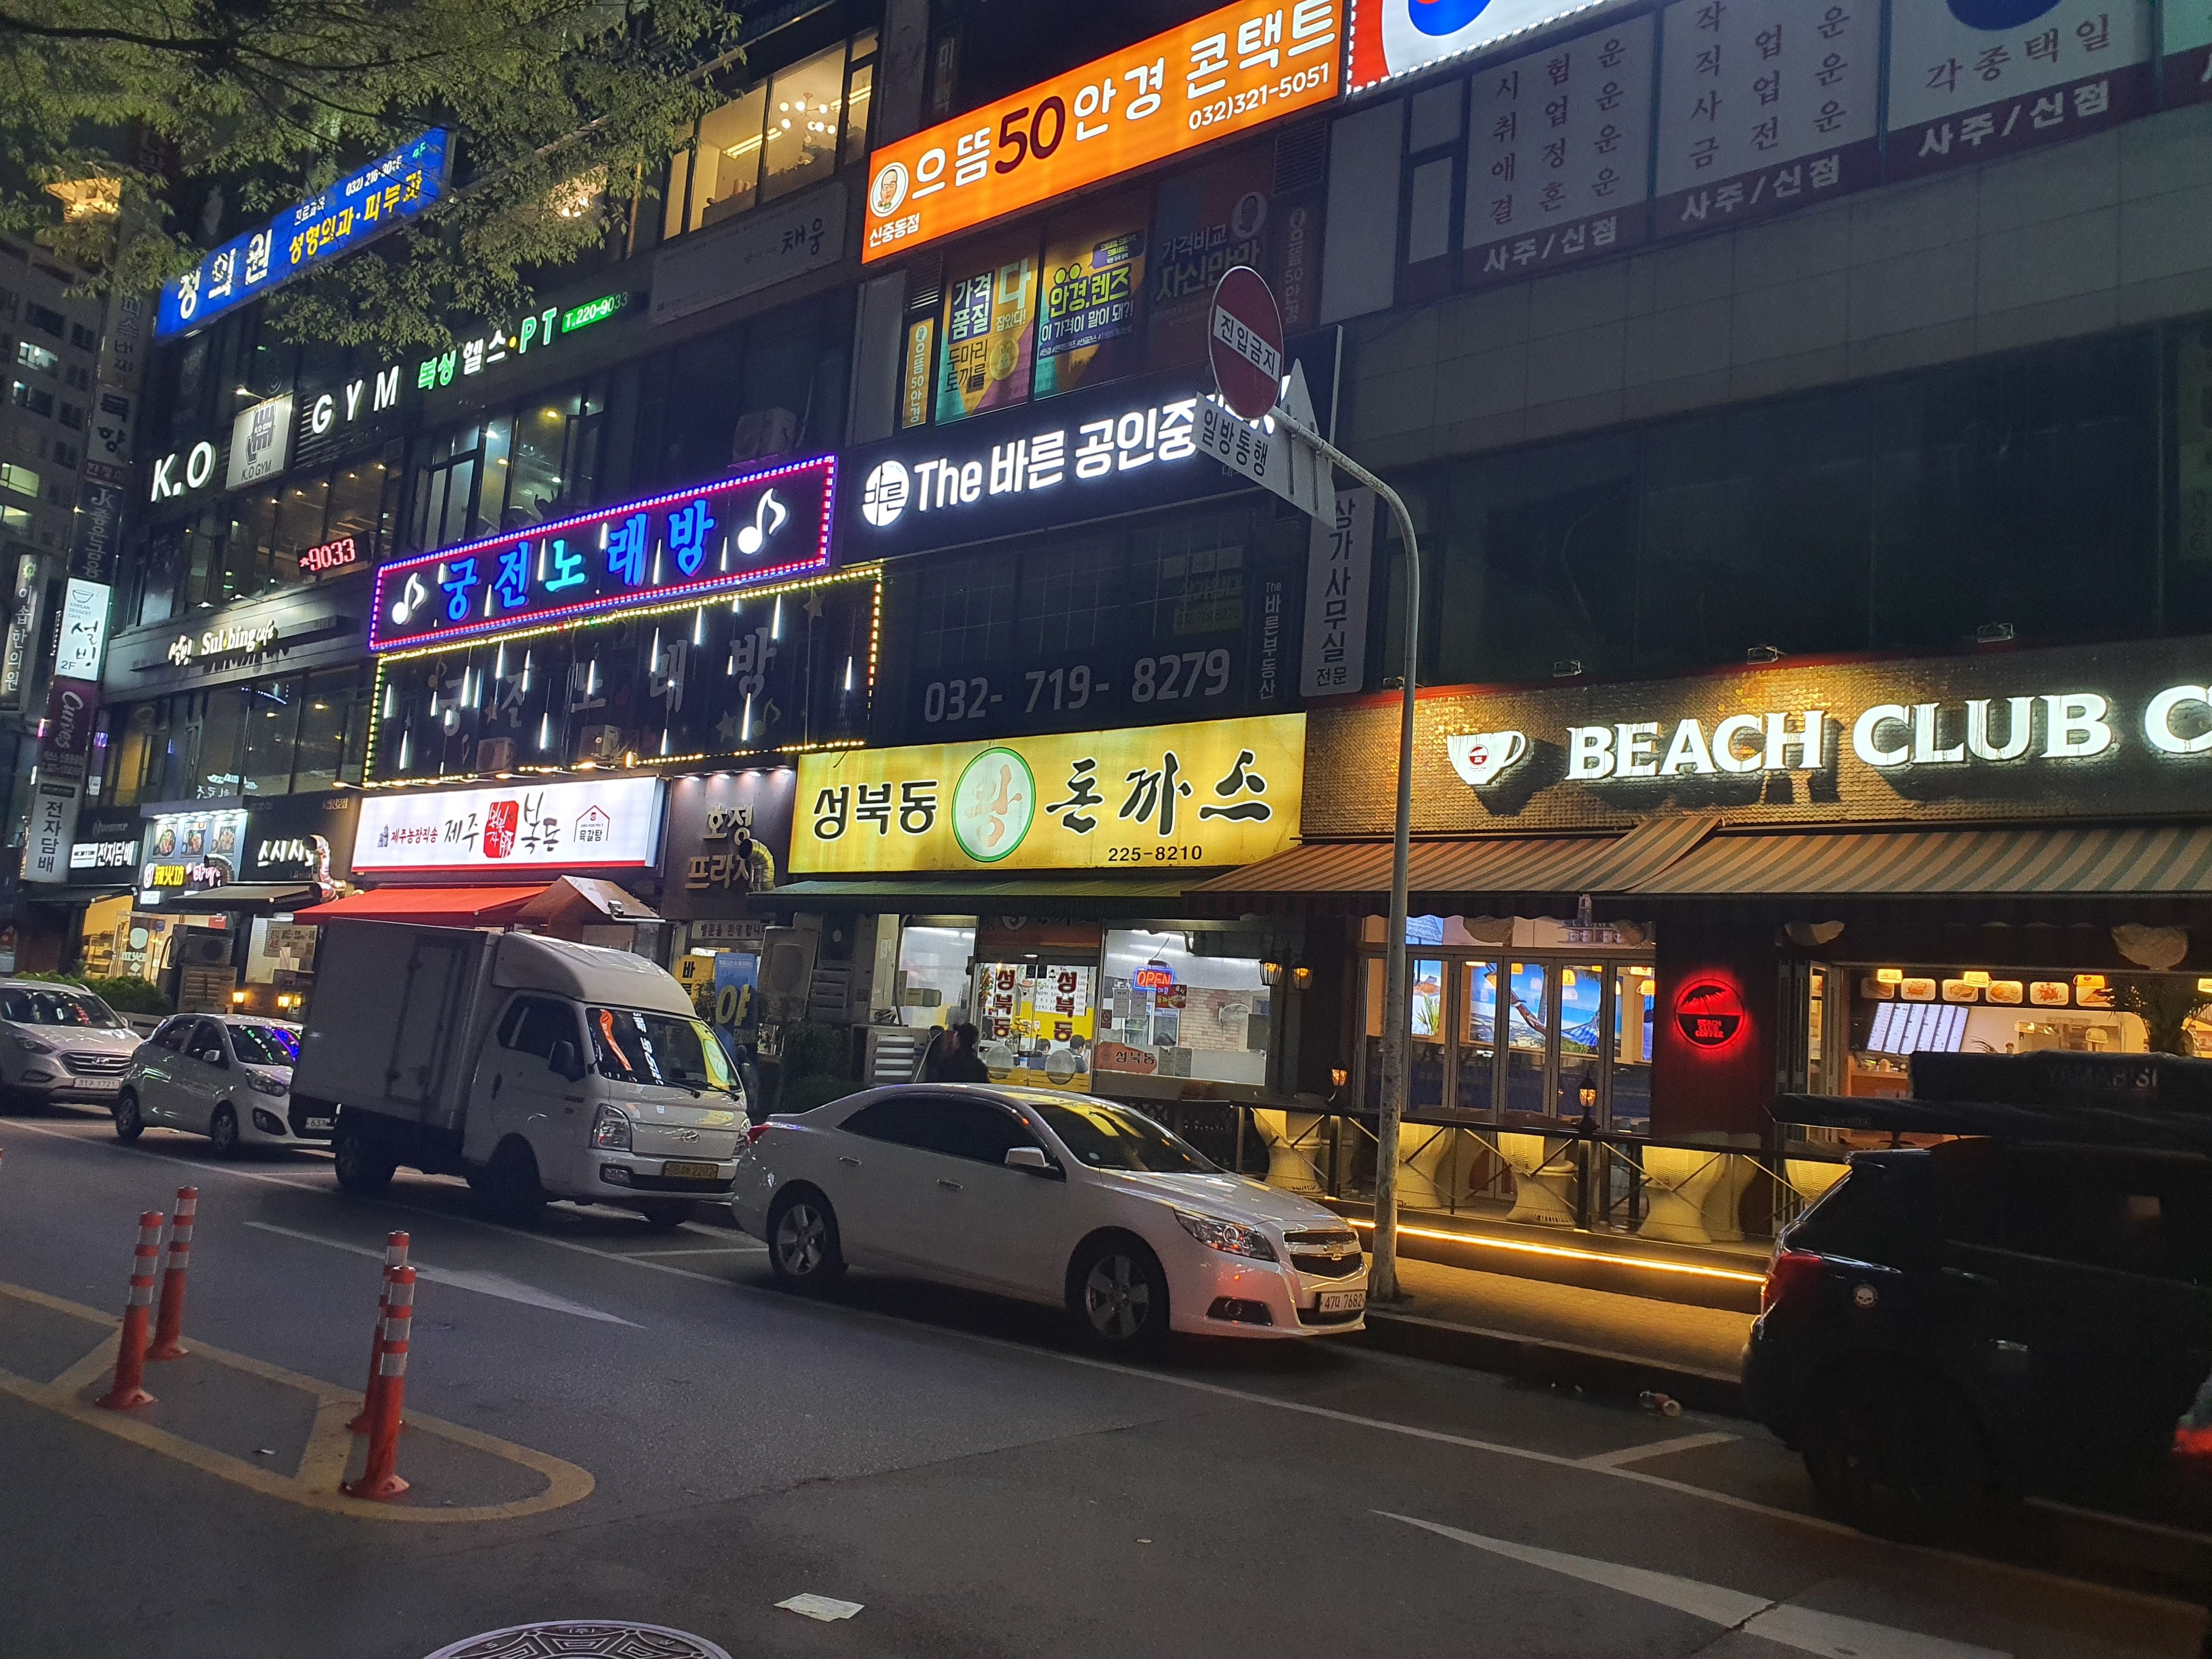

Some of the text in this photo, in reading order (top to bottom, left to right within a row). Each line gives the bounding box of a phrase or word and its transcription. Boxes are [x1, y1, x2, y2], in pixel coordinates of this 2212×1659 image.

[1186, 0, 1335, 100] 콘택트
[1188, 61, 1330, 131] 032)321-5051
[1918, 80, 2112, 158] 사주/신점
[1681, 153, 1841, 222] 사주/신점
[870, 212, 920, 249] 신중동점
[1161, 223, 1227, 261] 가격비교
[1482, 217, 1617, 273] 사주/신점
[953, 273, 991, 308] 가격
[998, 258, 1032, 310] 다
[952, 302, 990, 341] 품질
[996, 309, 1026, 332] 잡았다!
[1042, 324, 1052, 342] 이
[1054, 314, 1085, 338] 가격이
[1088, 306, 1110, 329] 말이
[947, 339, 988, 371] 두마리
[1221, 315, 1275, 375] 진입금지
[418, 350, 456, 390] 복싱
[945, 363, 986, 393] 토끼를
[1201, 409, 1268, 477] 일방통행
[151, 442, 213, 502] K.O
[256, 459, 272, 476] GYM
[913, 459, 982, 512] The
[990, 430, 1066, 499] 바른
[5, 585, 32, 691] 이솝한의원
[1259, 582, 1282, 700] The 바른부동산
[61, 661, 76, 670] 2F
[1132, 648, 1231, 704] 8279
[1317, 666, 1347, 687] 전문
[55, 691, 84, 748] Curves
[1565, 709, 1827, 781] BEACH
[1853, 692, 2113, 768] CLUB
[813, 780, 939, 841] 성북동
[1045, 748, 1272, 838] 돈까스
[37, 801, 63, 873] 전자담배
[391, 826, 438, 848] 제주농장직송
[444, 812, 480, 853] 제주
[579, 829, 603, 842] 육갈탕
[703, 803, 754, 847] 호정
[98, 841, 134, 867] 전자담배
[1108, 844, 1203, 863] 225-8210
[1137, 971, 1171, 986] OPEN
[994, 969, 1015, 1037] 성북동
[1054, 971, 1077, 1042] 성북동
[1116, 1051, 1156, 1064] 성북동
[1344, 1293, 1363, 1308] 7682
